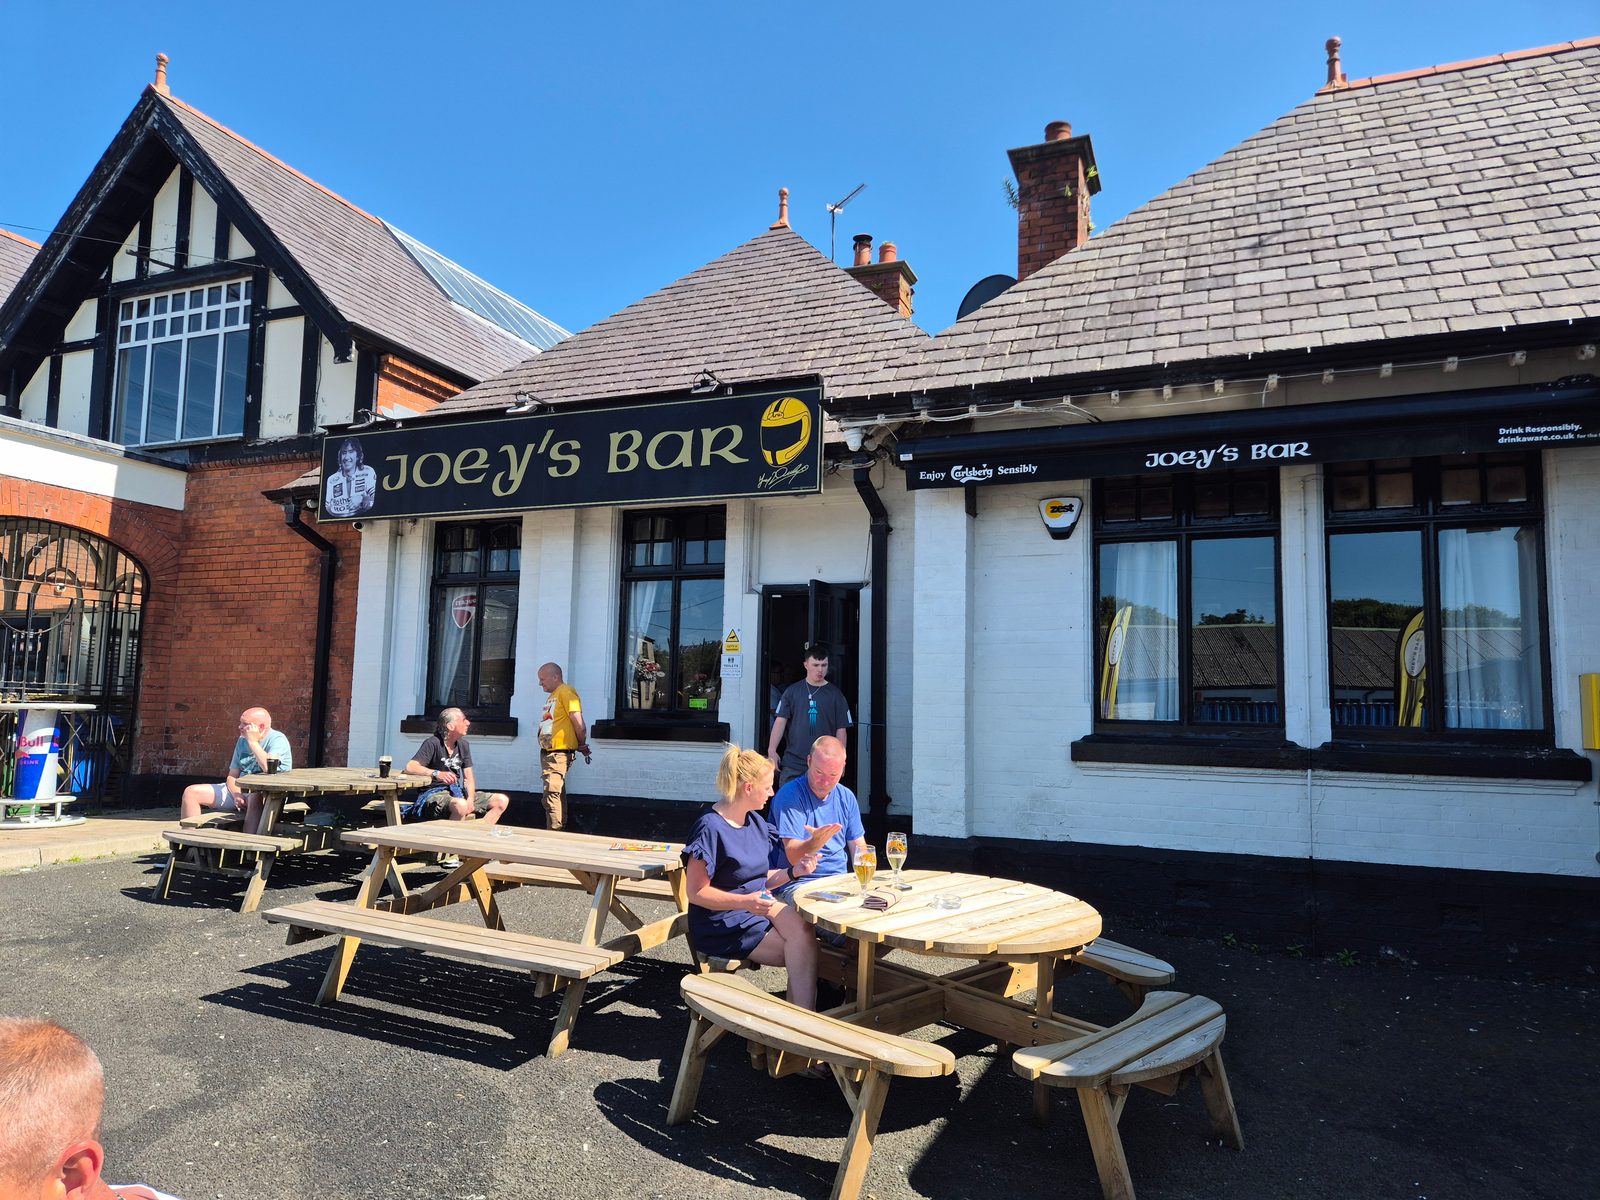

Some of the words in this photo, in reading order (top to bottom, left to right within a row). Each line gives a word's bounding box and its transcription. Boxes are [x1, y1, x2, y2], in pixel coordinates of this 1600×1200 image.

[1499, 427, 1524, 435] Drink
[1525, 423, 1582, 433] Responsibly.
[1498, 433, 1575, 444] drinkaware.co.uk
[919, 471, 947, 482] Enjoy
[950, 463, 994, 484] Carlsberg
[997, 463, 1038, 475] Sensibly
[1050, 503, 1075, 514] zest
[20, 735, 44, 747] Bull
